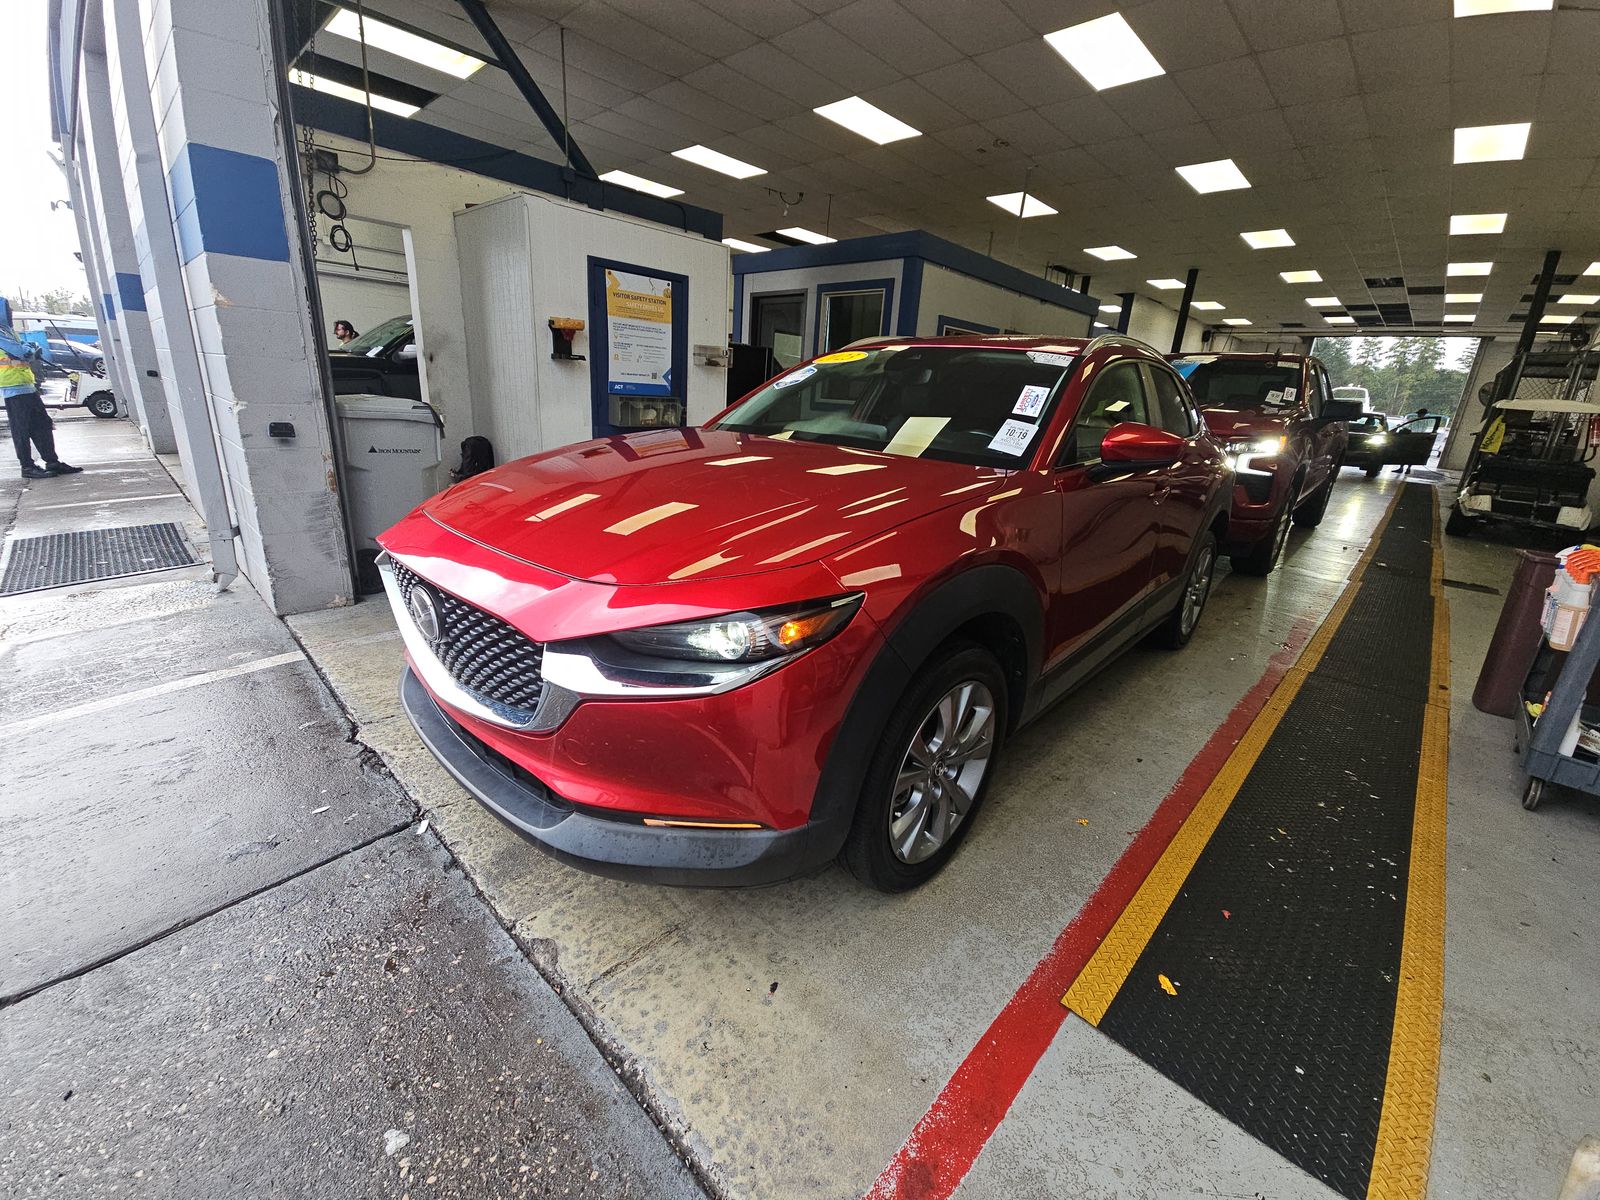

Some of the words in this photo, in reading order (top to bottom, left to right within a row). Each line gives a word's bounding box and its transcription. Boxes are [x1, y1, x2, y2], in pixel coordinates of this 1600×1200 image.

[613, 292, 630, 300] VISITOR
[631, 294, 648, 303] SAFETY
[648, 297, 667, 306] STATION
